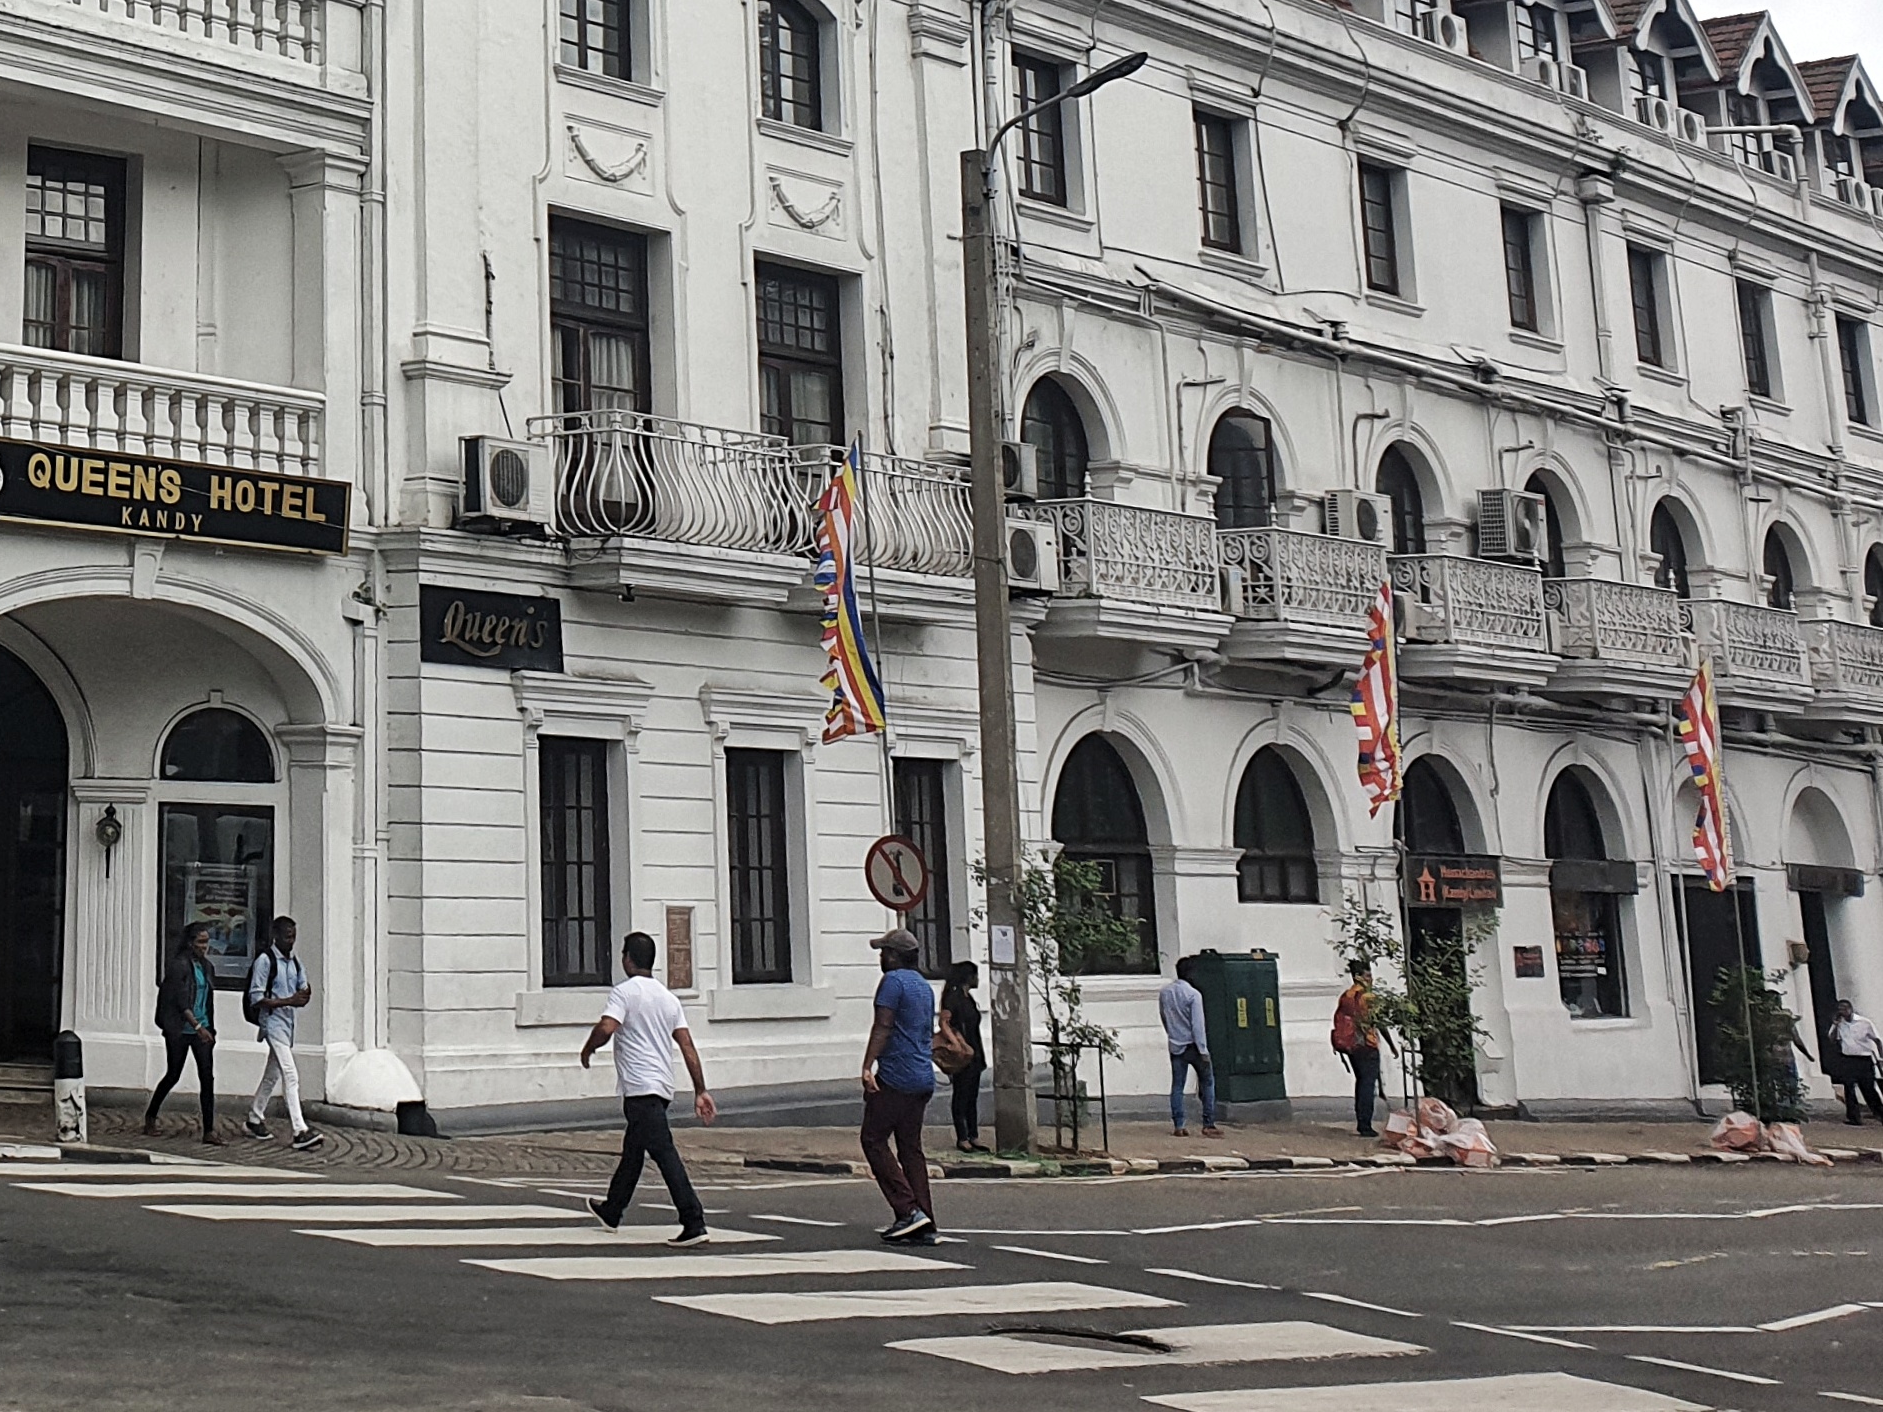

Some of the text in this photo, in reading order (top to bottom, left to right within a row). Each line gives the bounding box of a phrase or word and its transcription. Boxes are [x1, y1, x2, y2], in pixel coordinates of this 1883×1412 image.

[28, 452, 182, 505] QUEEN'S
[209, 474, 327, 522] HOTEL
[121, 505, 204, 532] KANDY
[438, 600, 548, 657] Queen's
